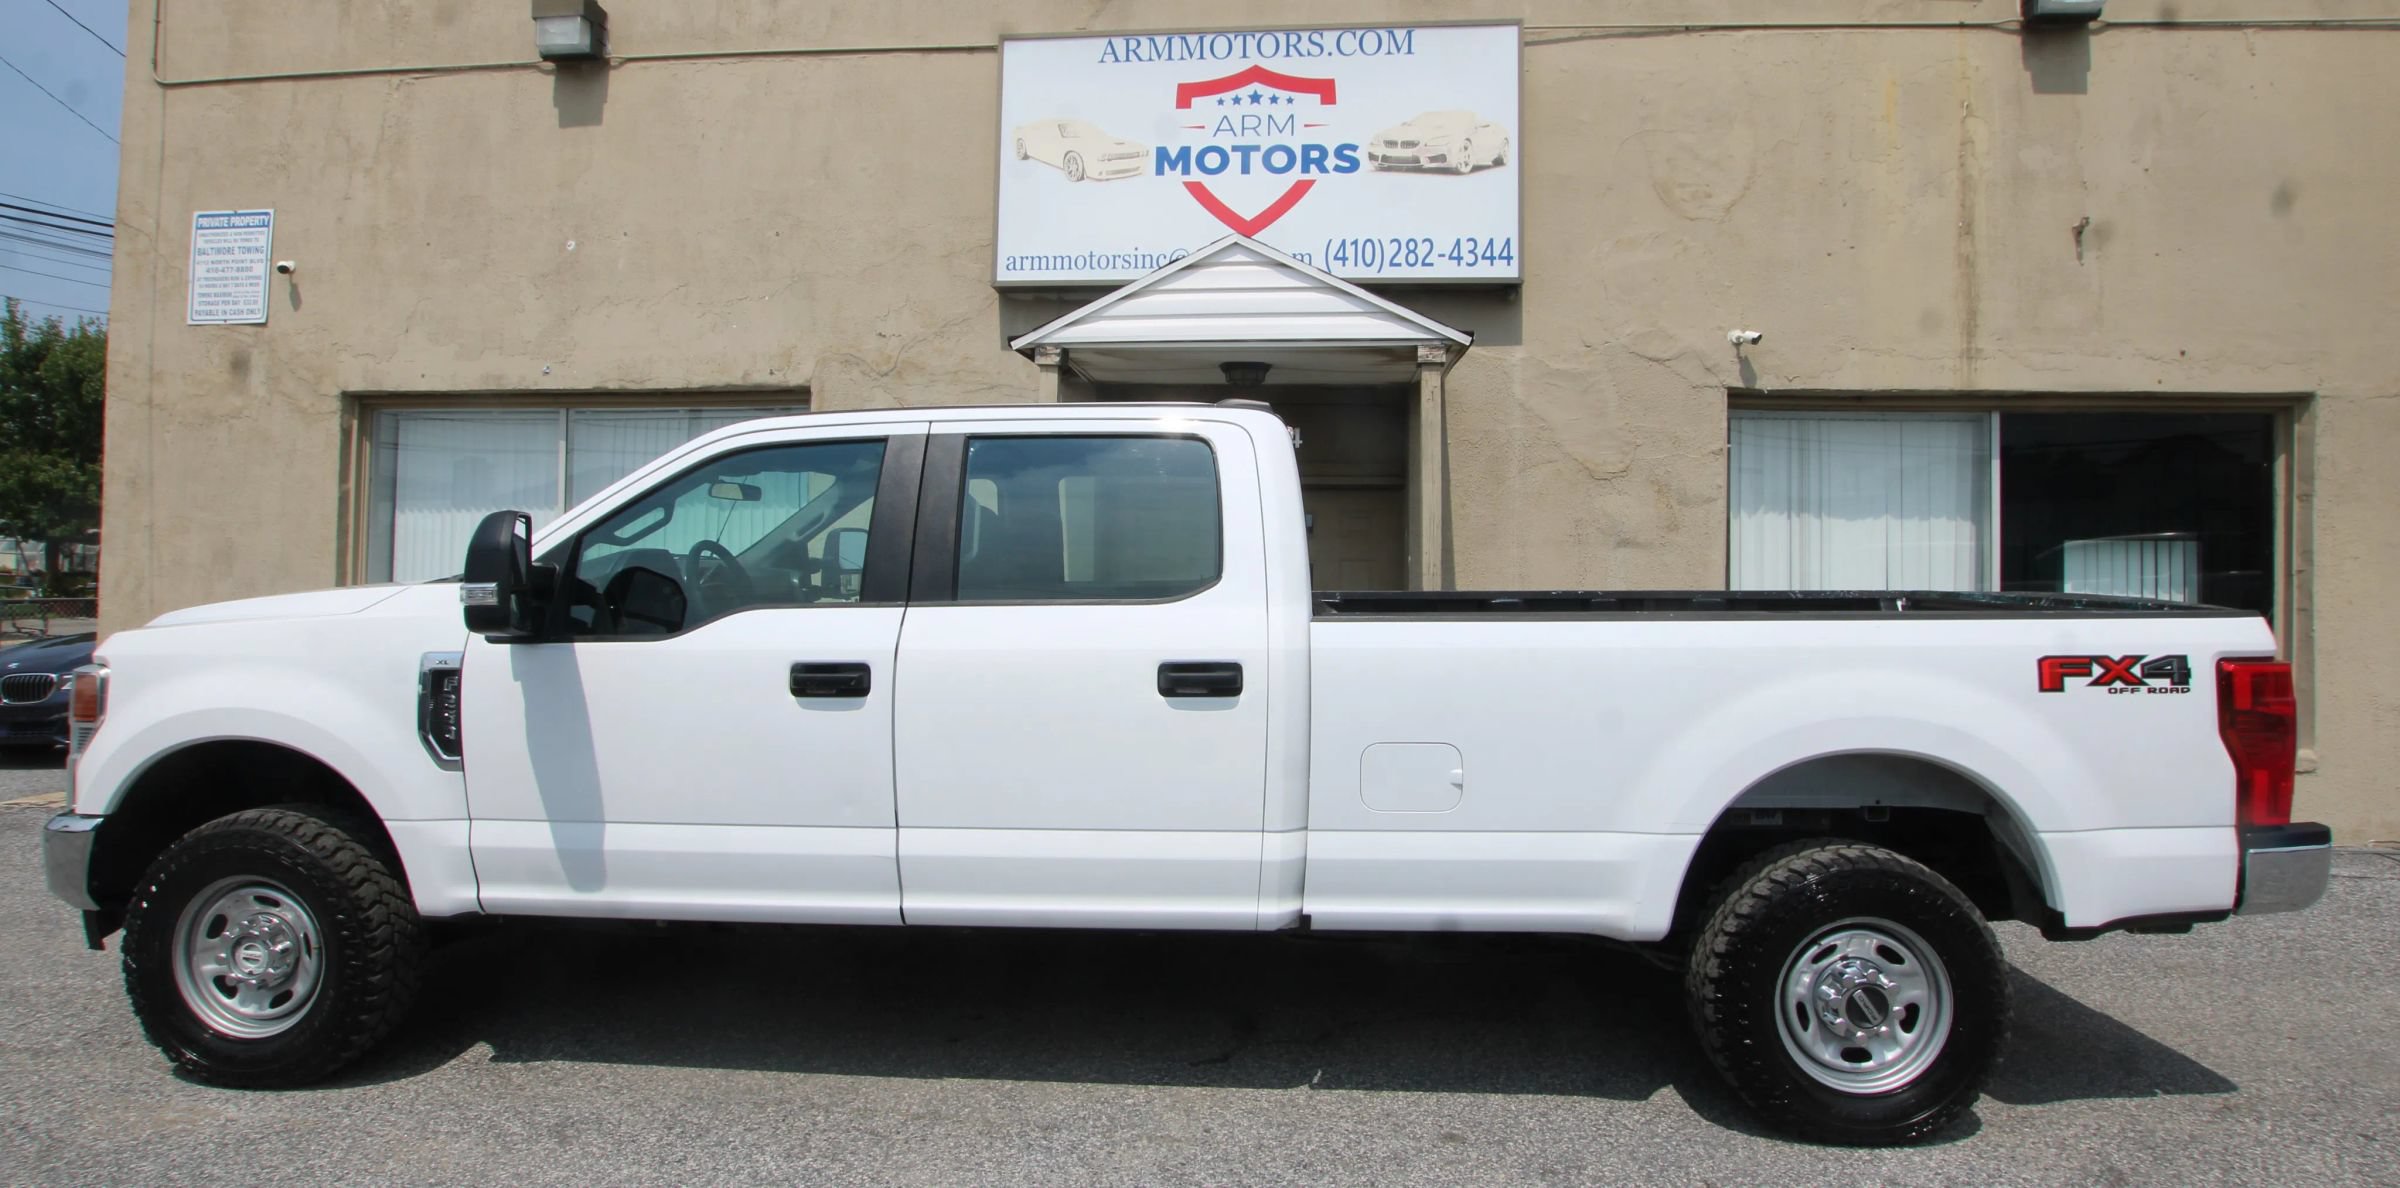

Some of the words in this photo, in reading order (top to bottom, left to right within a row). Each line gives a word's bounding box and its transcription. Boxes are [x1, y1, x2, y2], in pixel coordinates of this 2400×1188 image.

[1097, 28, 1416, 64] ARMMOTORS.COM
[1212, 113, 1295, 138] ARM
[1155, 143, 1361, 176] MOTORS
[198, 217, 230, 228] PRIVATE
[230, 215, 270, 226] PROPERTY
[197, 246, 235, 256] BALTIMORE
[237, 245, 265, 255] TOWING
[1325, 237, 1514, 274] (410)282-4344
[229, 308, 245, 316] CASH
[245, 308, 261, 316] ONLY
[2037, 654, 2192, 693] FX4
[2107, 686, 2141, 694] OFF
[2146, 686, 2191, 694] ROAD
